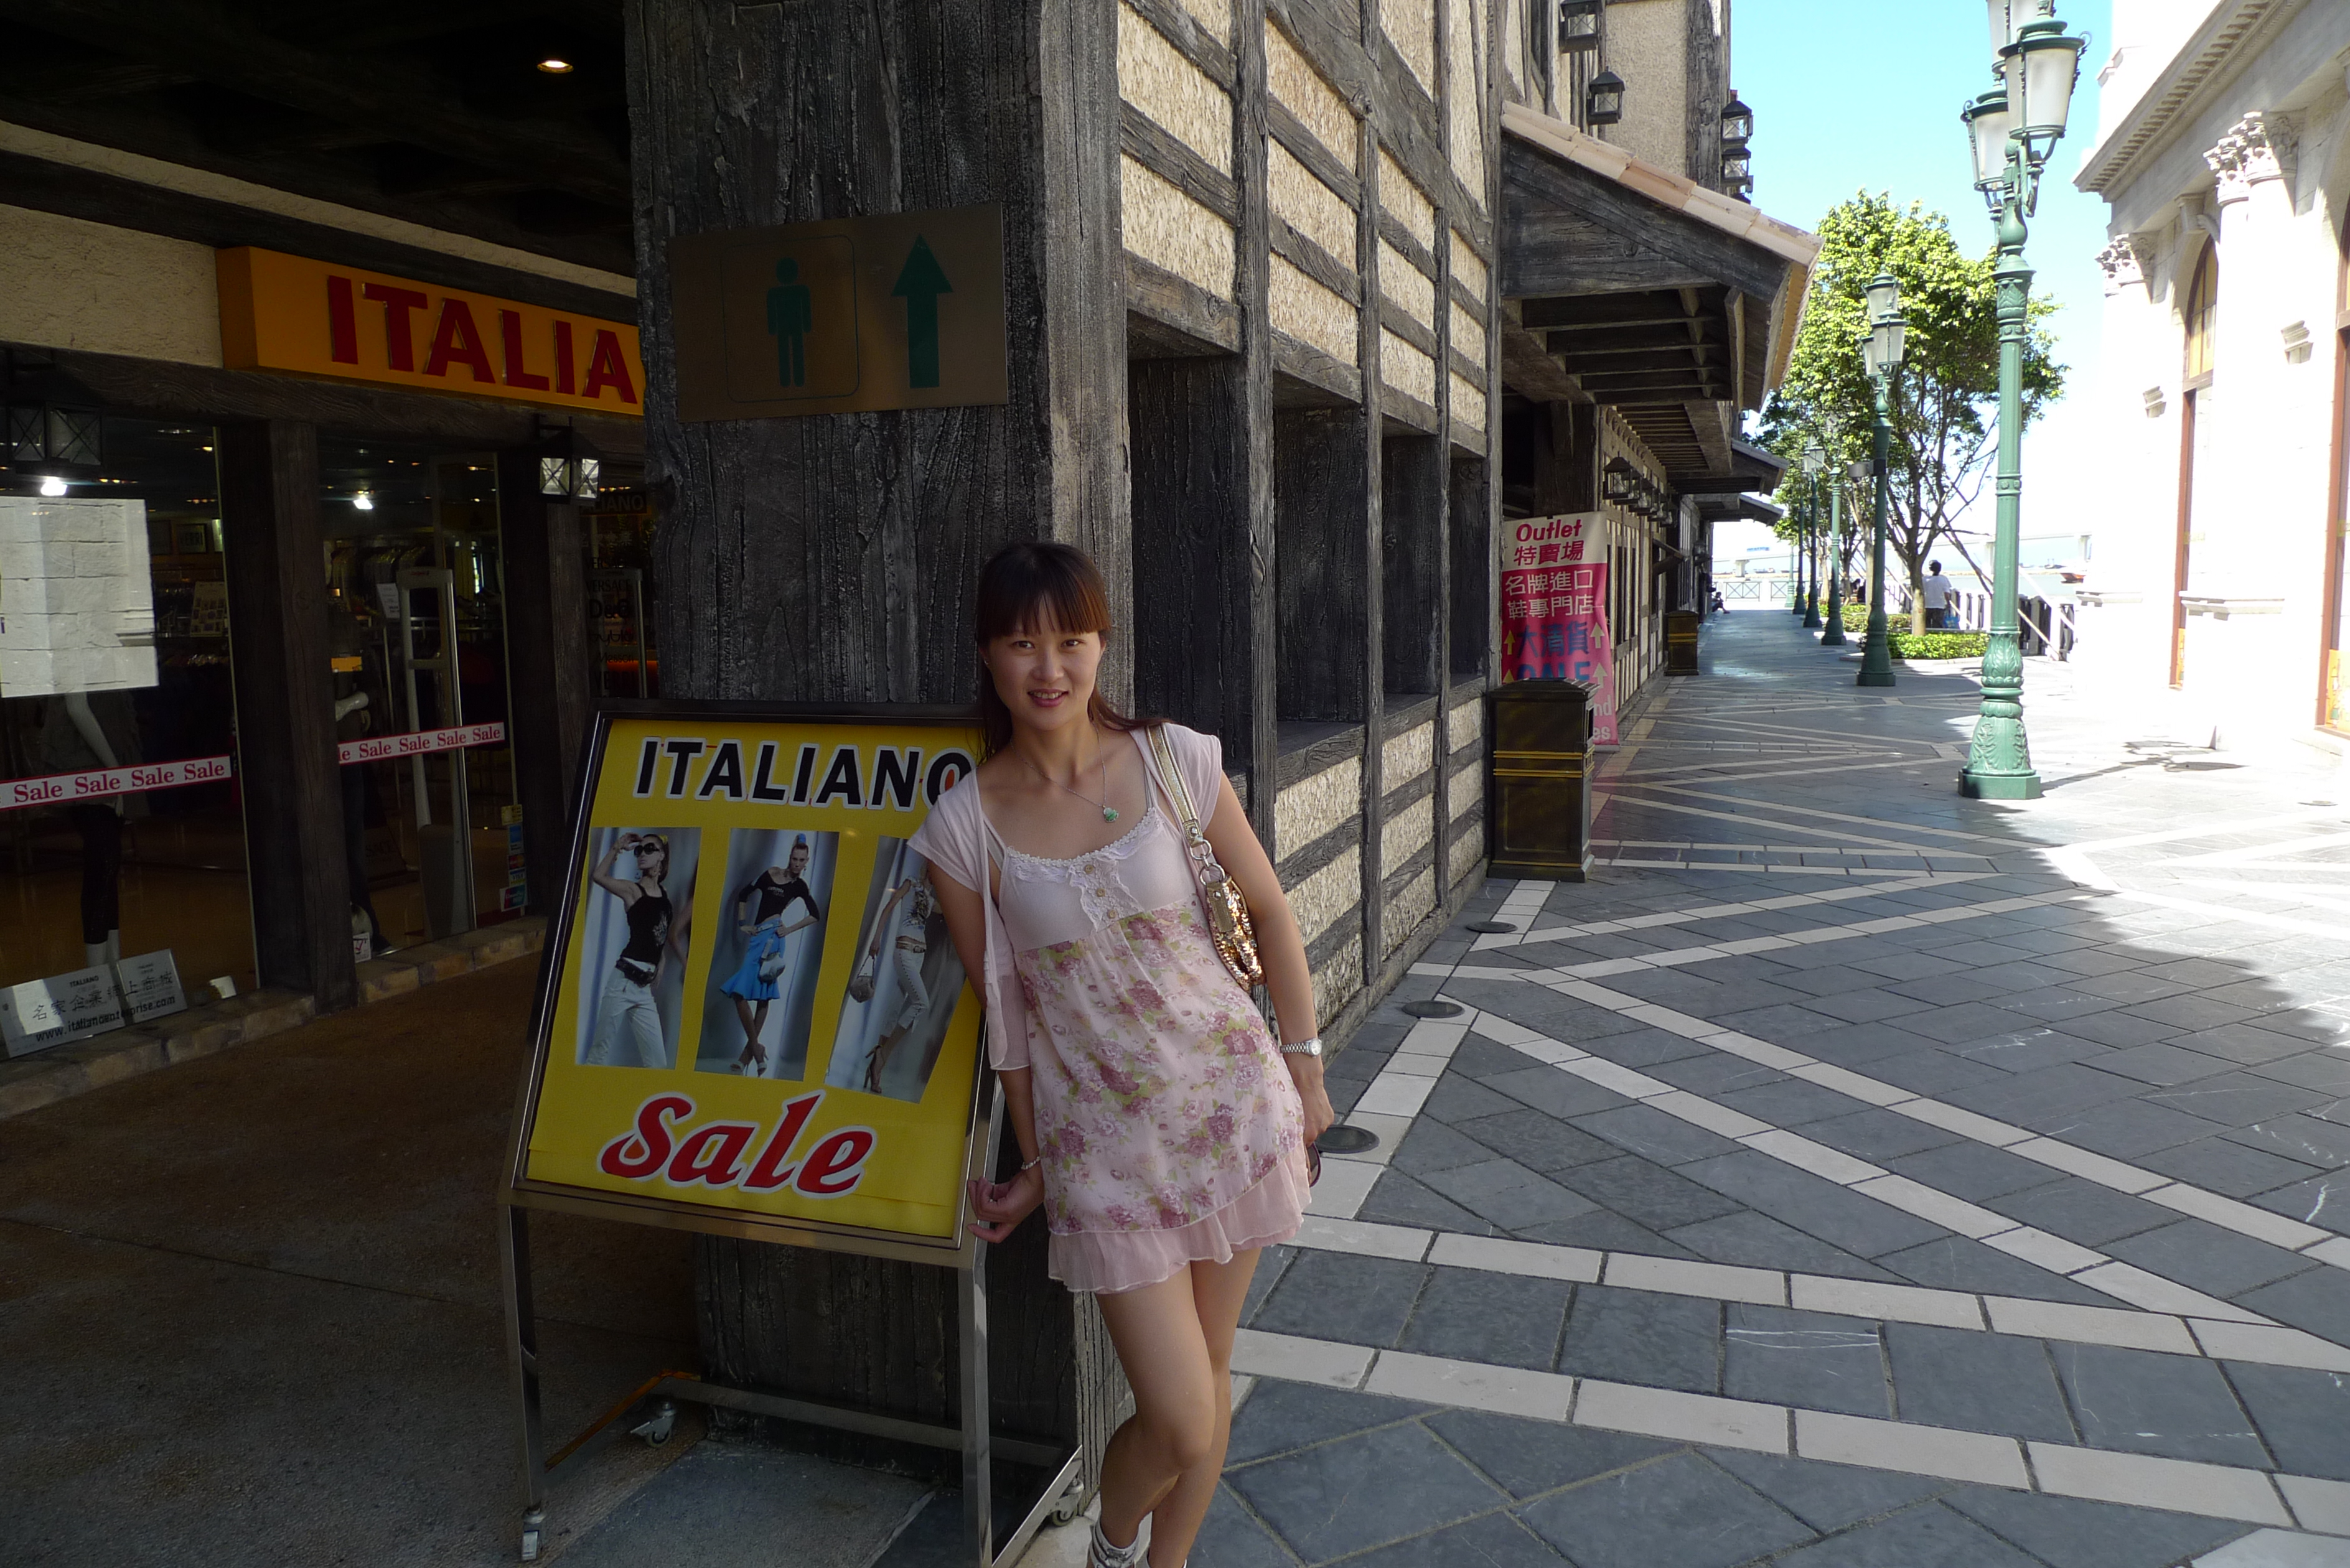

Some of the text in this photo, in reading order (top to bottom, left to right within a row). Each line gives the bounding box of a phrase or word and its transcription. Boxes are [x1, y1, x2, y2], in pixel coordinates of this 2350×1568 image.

[326, 275, 639, 404] ITALIA
[1516, 519, 1583, 542] Outlet
[1514, 540, 1585, 566] 特賣場
[586, 579, 632, 592] VERSACE
[1505, 569, 1593, 596] 名牌進口
[1507, 594, 1594, 620] 鞋專門店
[1517, 621, 1589, 659] 大清貨
[359, 742, 391, 758] Sale
[399, 735, 430, 752] Sale
[437, 731, 466, 746] Sale
[472, 726, 500, 741] Sale
[14, 761, 225, 803] Sale Sale Sale Sale
[634, 738, 976, 811] ITALIANO
[70, 975, 99, 988] ITALIANO
[599, 1092, 875, 1196] Sale
